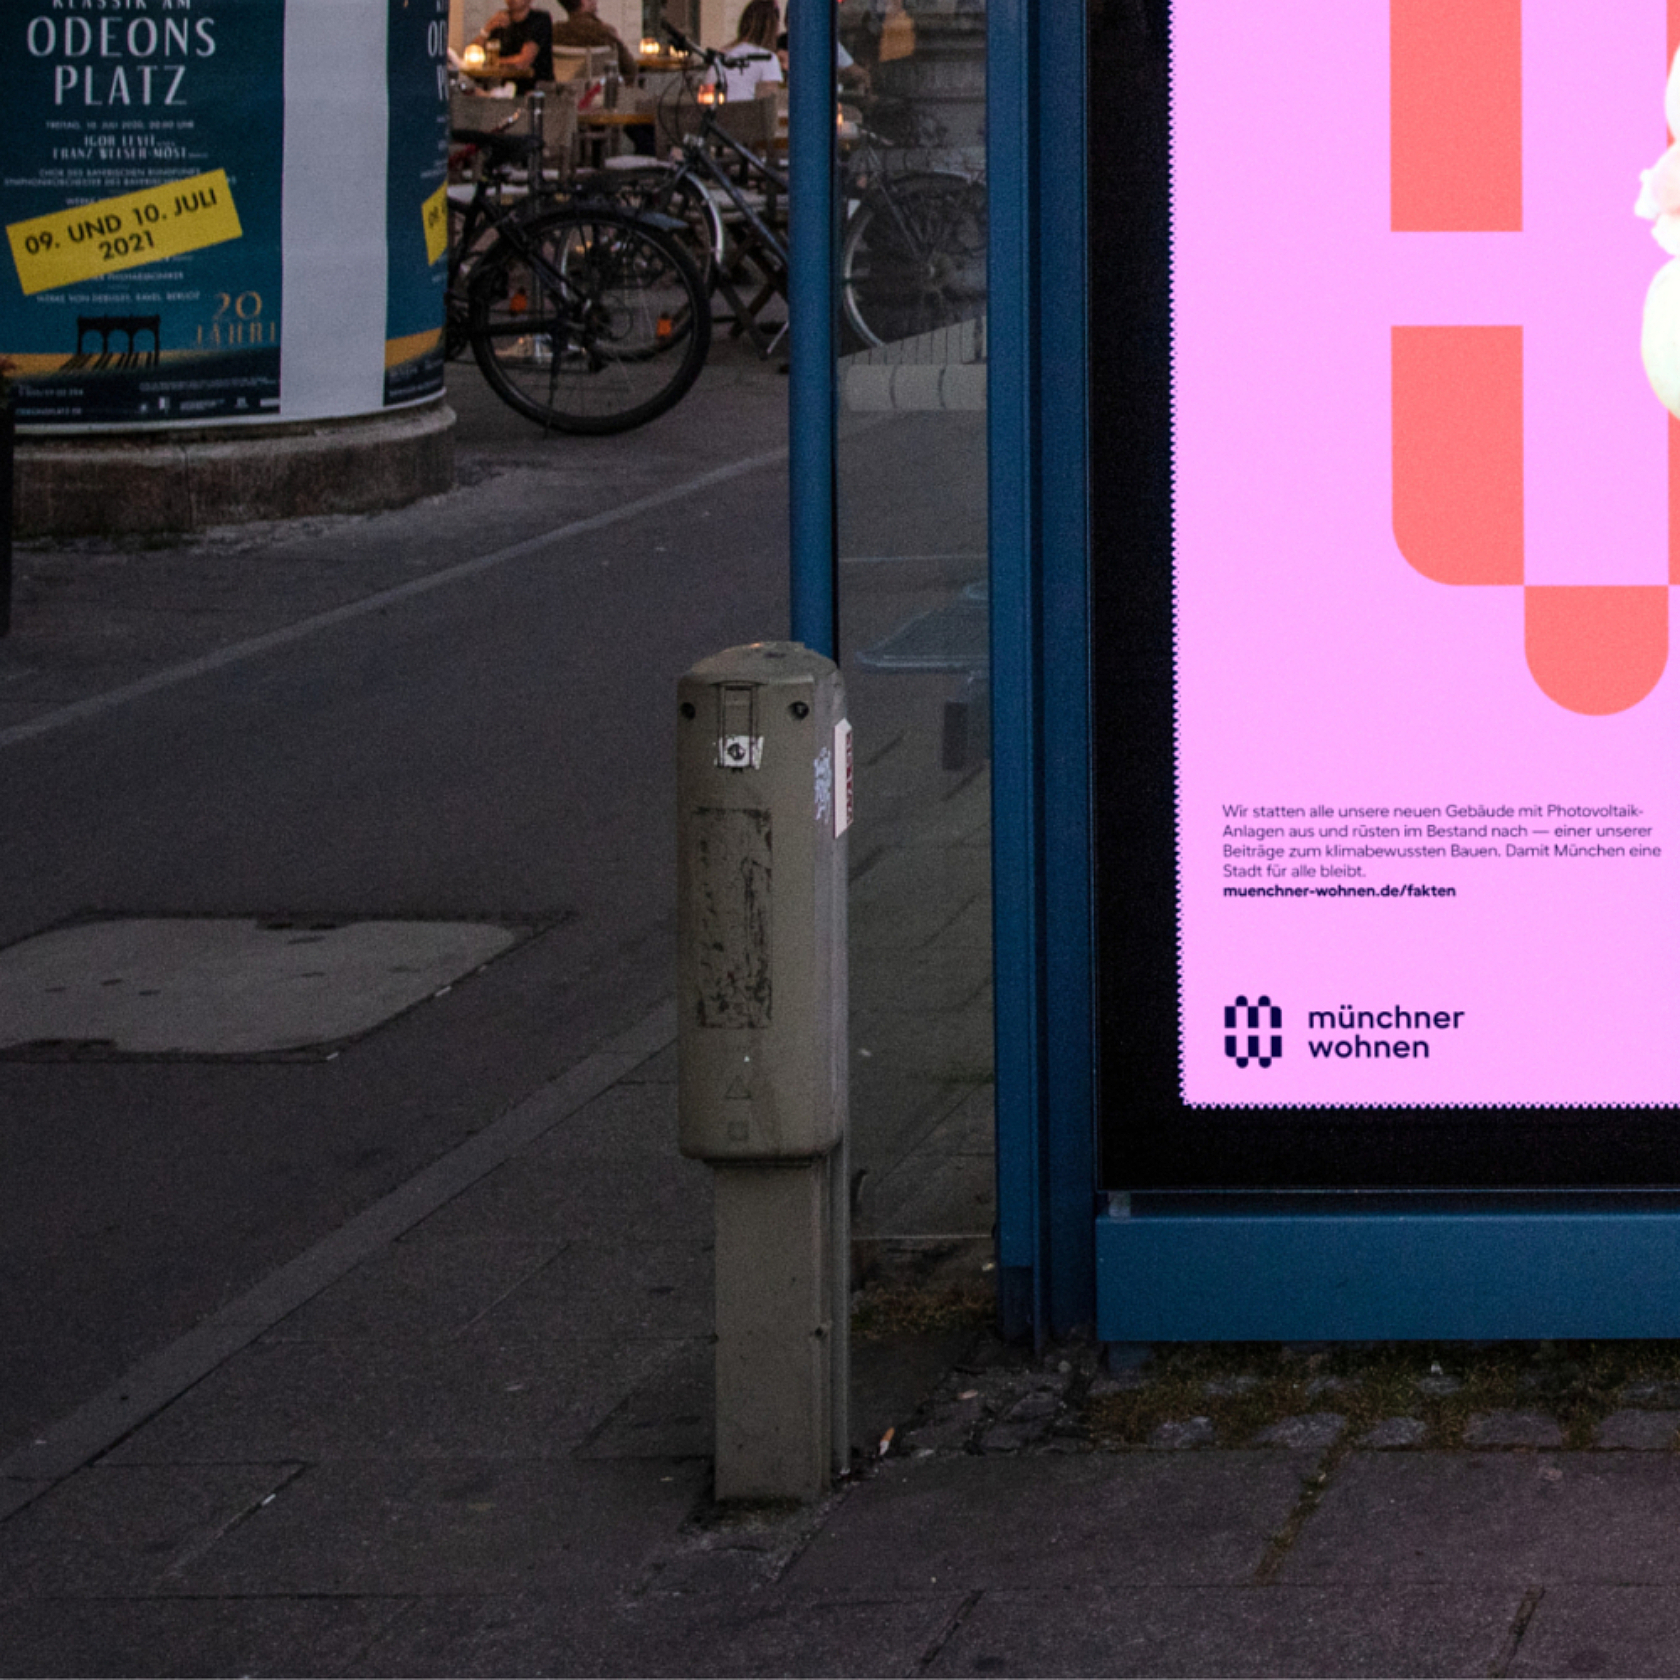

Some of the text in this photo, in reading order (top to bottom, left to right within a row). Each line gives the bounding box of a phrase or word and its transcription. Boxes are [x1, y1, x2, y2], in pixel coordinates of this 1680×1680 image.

[27, 15, 217, 57] ODEONS
[54, 64, 188, 106] PLATZ
[24, 187, 218, 255] 09. UND 10. JULI
[98, 230, 156, 262] 2021
[211, 290, 263, 321] 20
[1222, 803, 1644, 819] Wir statten alle unsere neuen Gebäude mit Photovoltaik-
[1222, 824, 1286, 841] Anlagen
[1288, 827, 1316, 838] aus
[1319, 824, 1349, 838] und
[1352, 824, 1401, 838] rüsten
[1404, 824, 1423, 838] im
[1426, 824, 1488, 838] Bestand
[1491, 824, 1529, 838] nach
[1553, 824, 1593, 838] einer
[1596, 826, 1653, 838] unserer
[1223, 842, 1663, 861] Beiträge zum klimabewussten Bauen. Damit München eine
[1222, 863, 1367, 878] Stadt für alle bleibt.
[1222, 882, 1458, 899] muenchner-wohnen.de/fakten
[1308, 1004, 1466, 1030] münchner
[1307, 1033, 1430, 1059] wohnen
